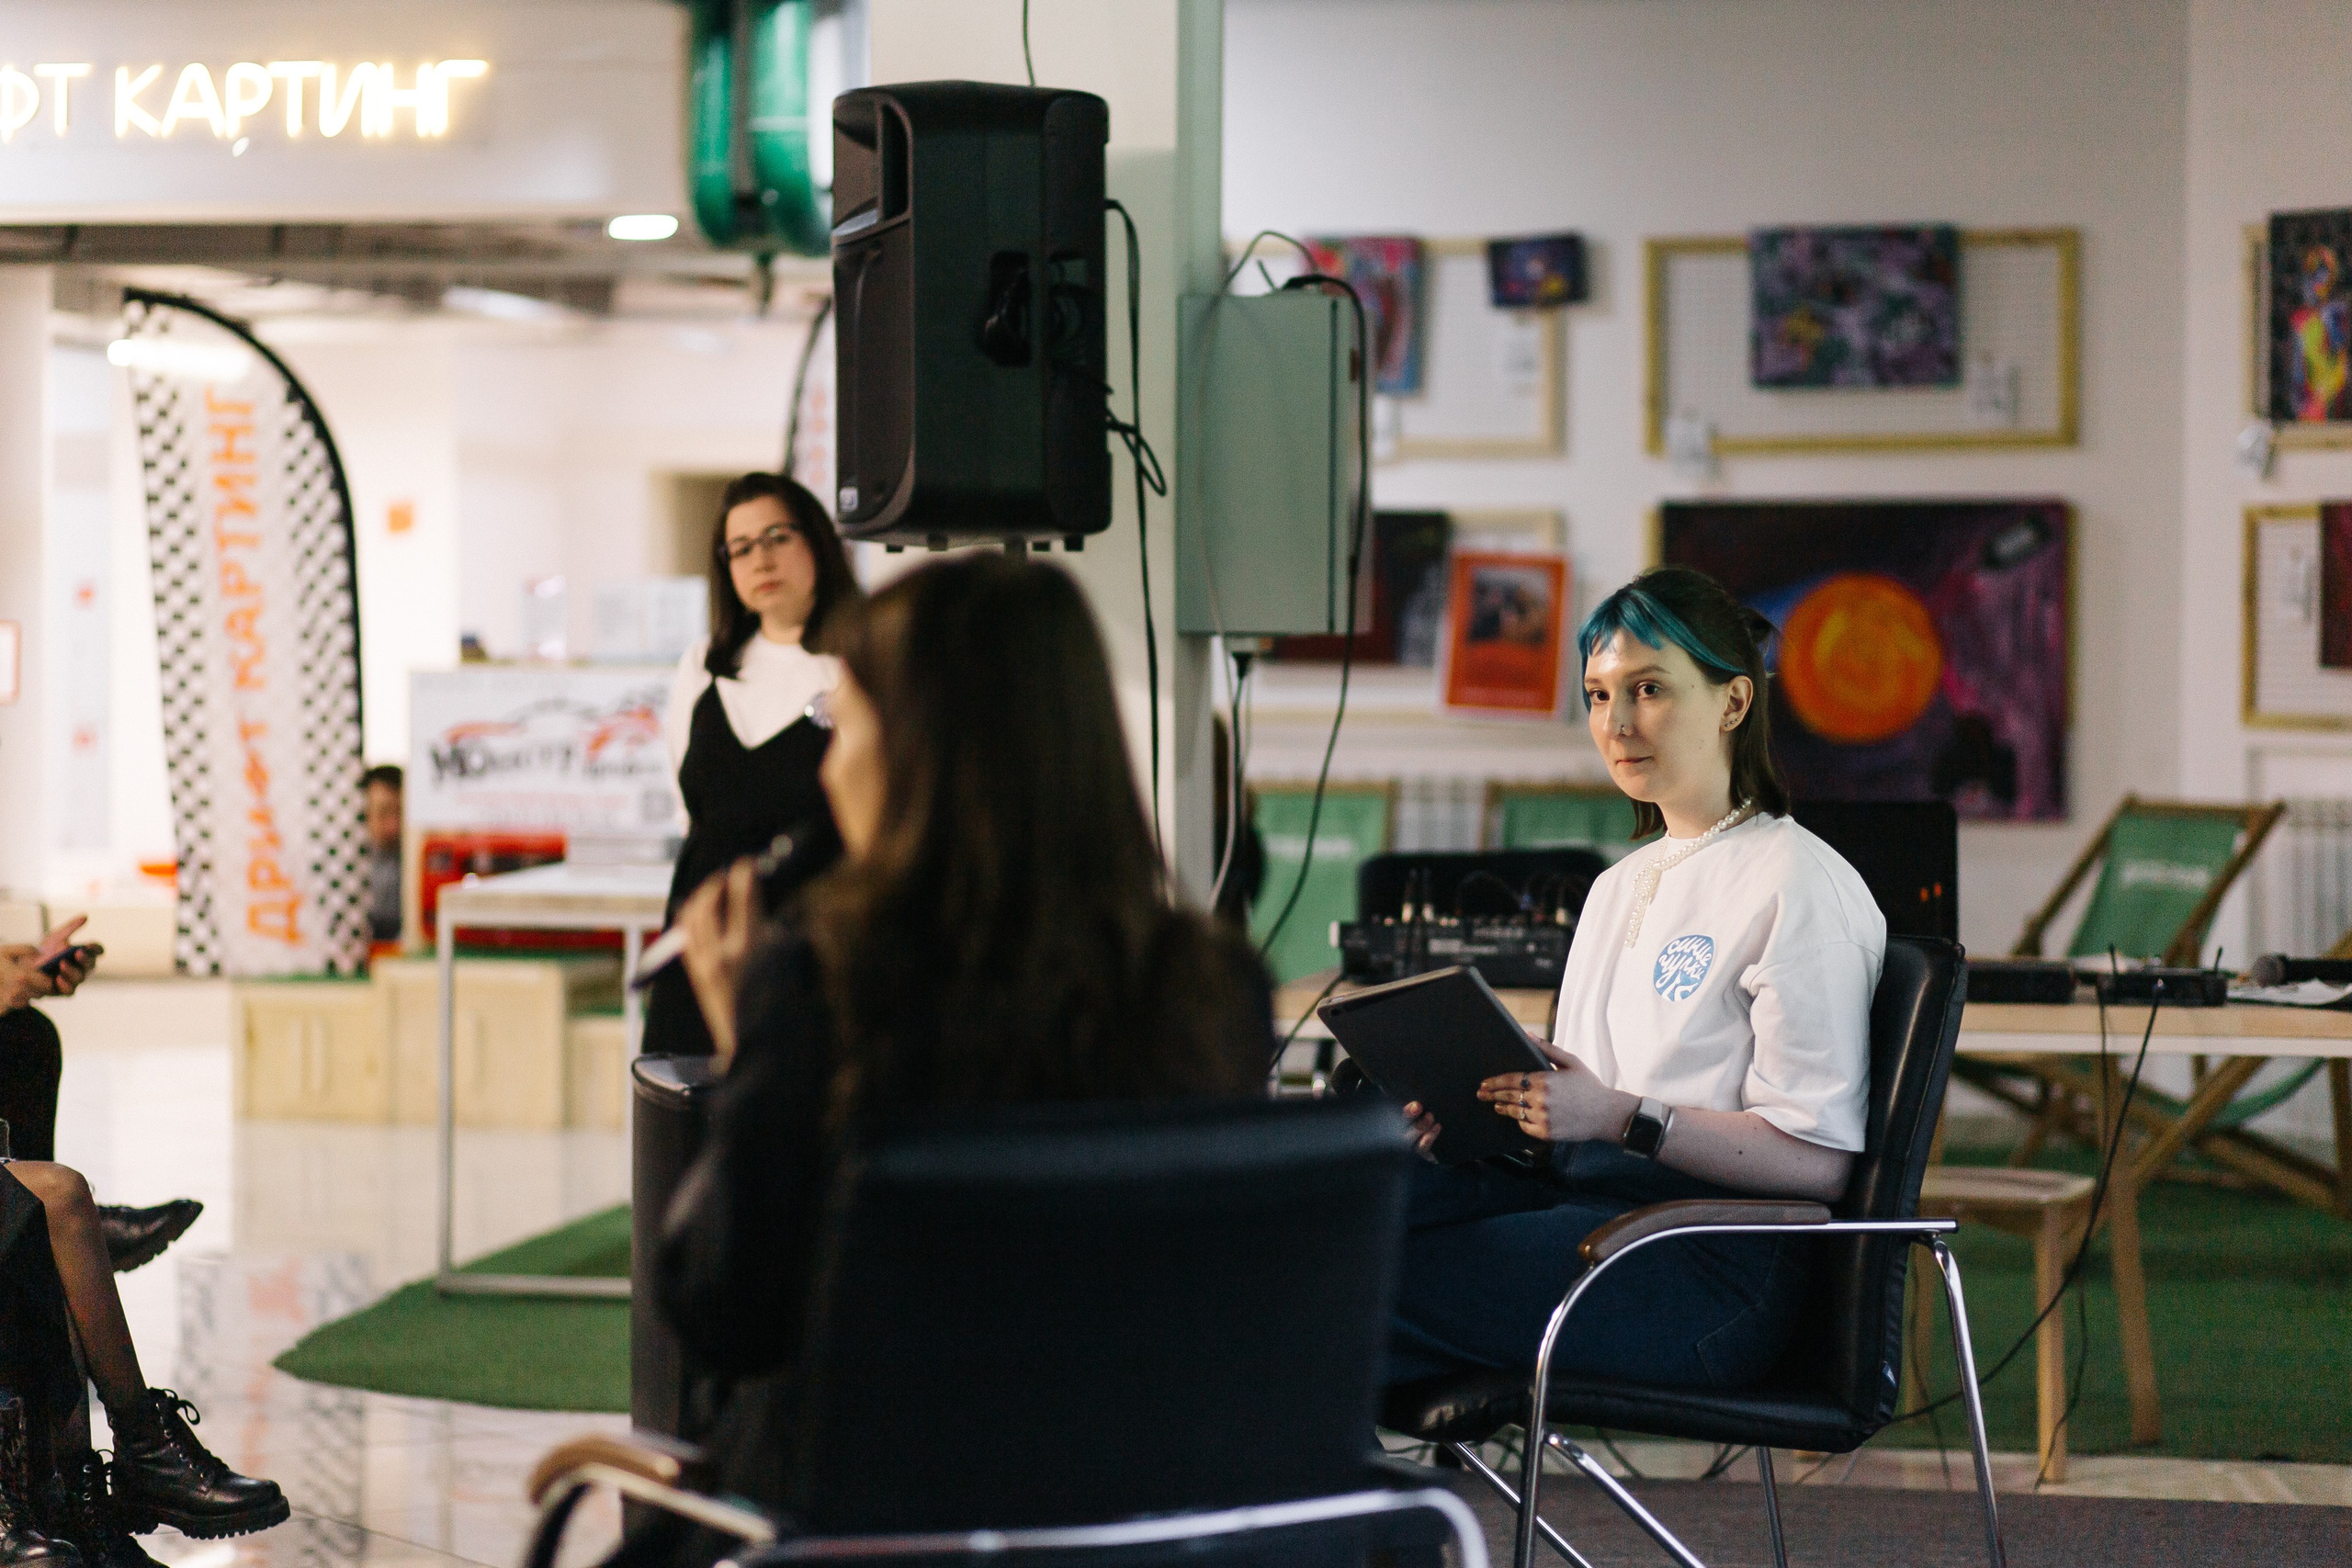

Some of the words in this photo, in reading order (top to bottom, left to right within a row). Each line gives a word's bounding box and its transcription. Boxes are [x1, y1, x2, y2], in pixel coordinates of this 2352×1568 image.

[114, 59, 489, 139] КАРТИНГ
[204, 384, 267, 691] КАРТИНГ
[237, 713, 307, 948] ДРИФТ
